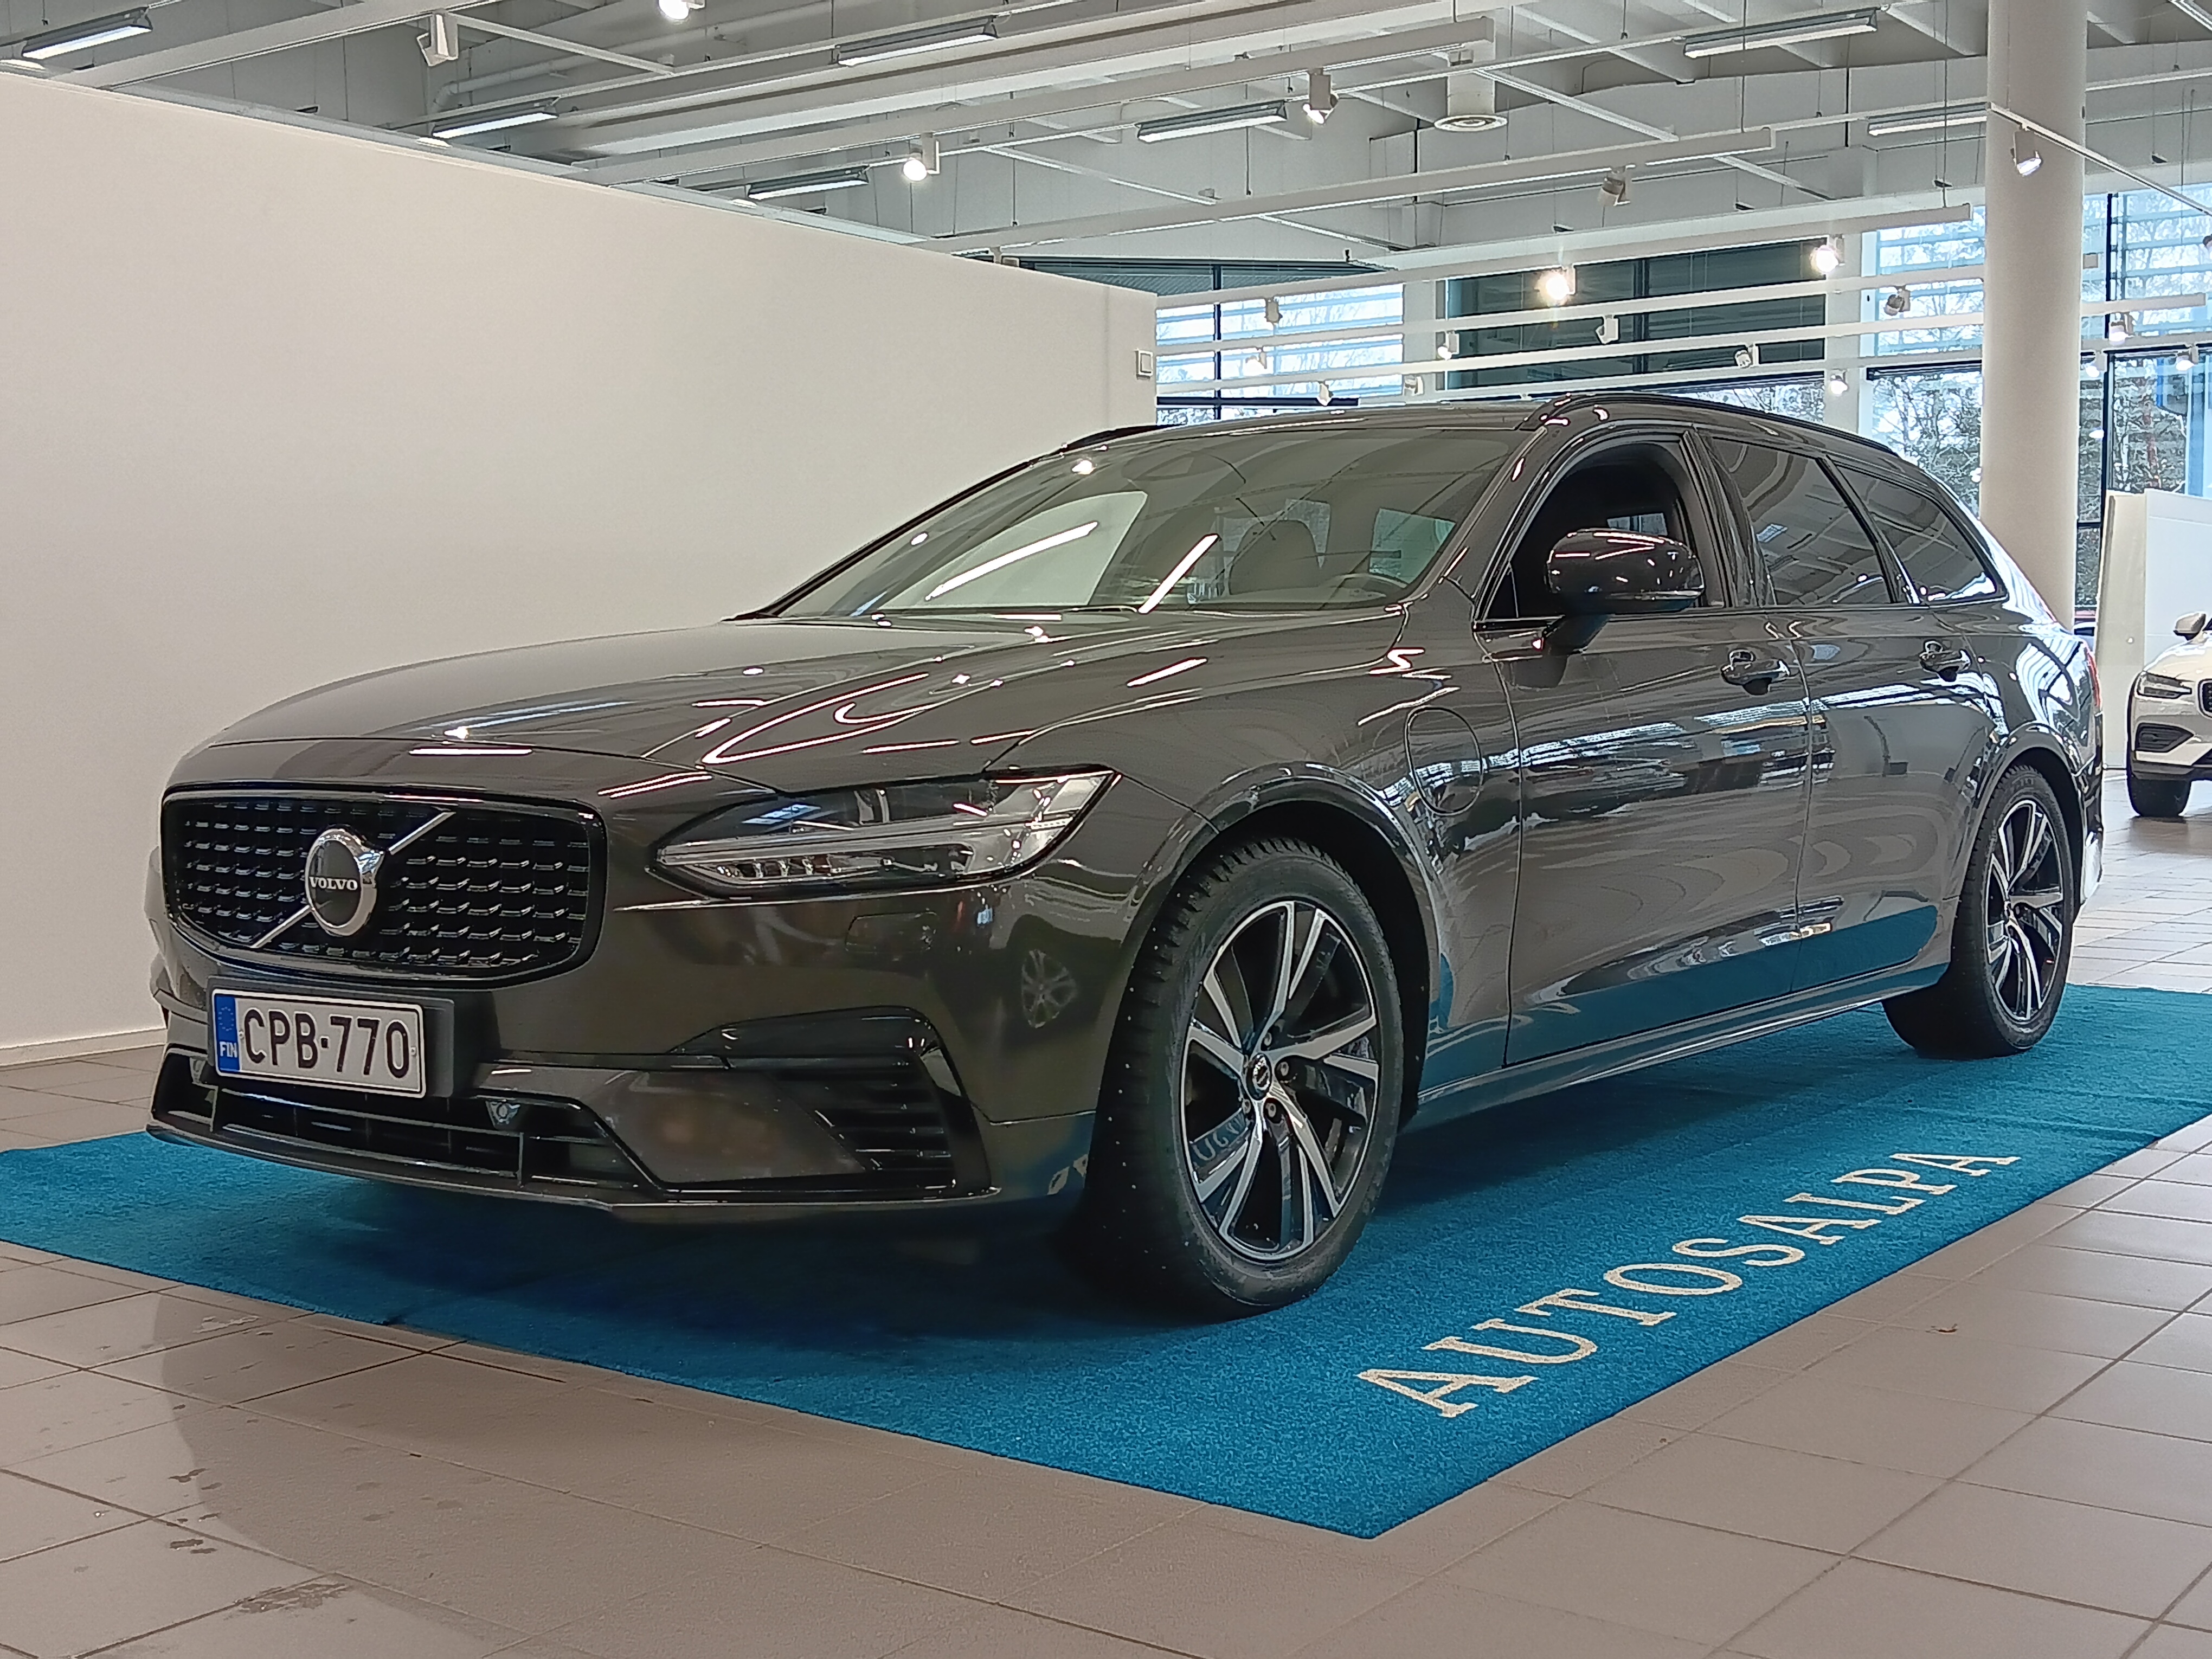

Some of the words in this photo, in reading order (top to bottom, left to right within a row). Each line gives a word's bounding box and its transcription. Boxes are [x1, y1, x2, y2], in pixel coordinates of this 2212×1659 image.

[308, 876, 358, 891] VOLVO
[220, 1041, 238, 1058] FIN
[1356, 1153, 2021, 1418] AUTOSALPA
